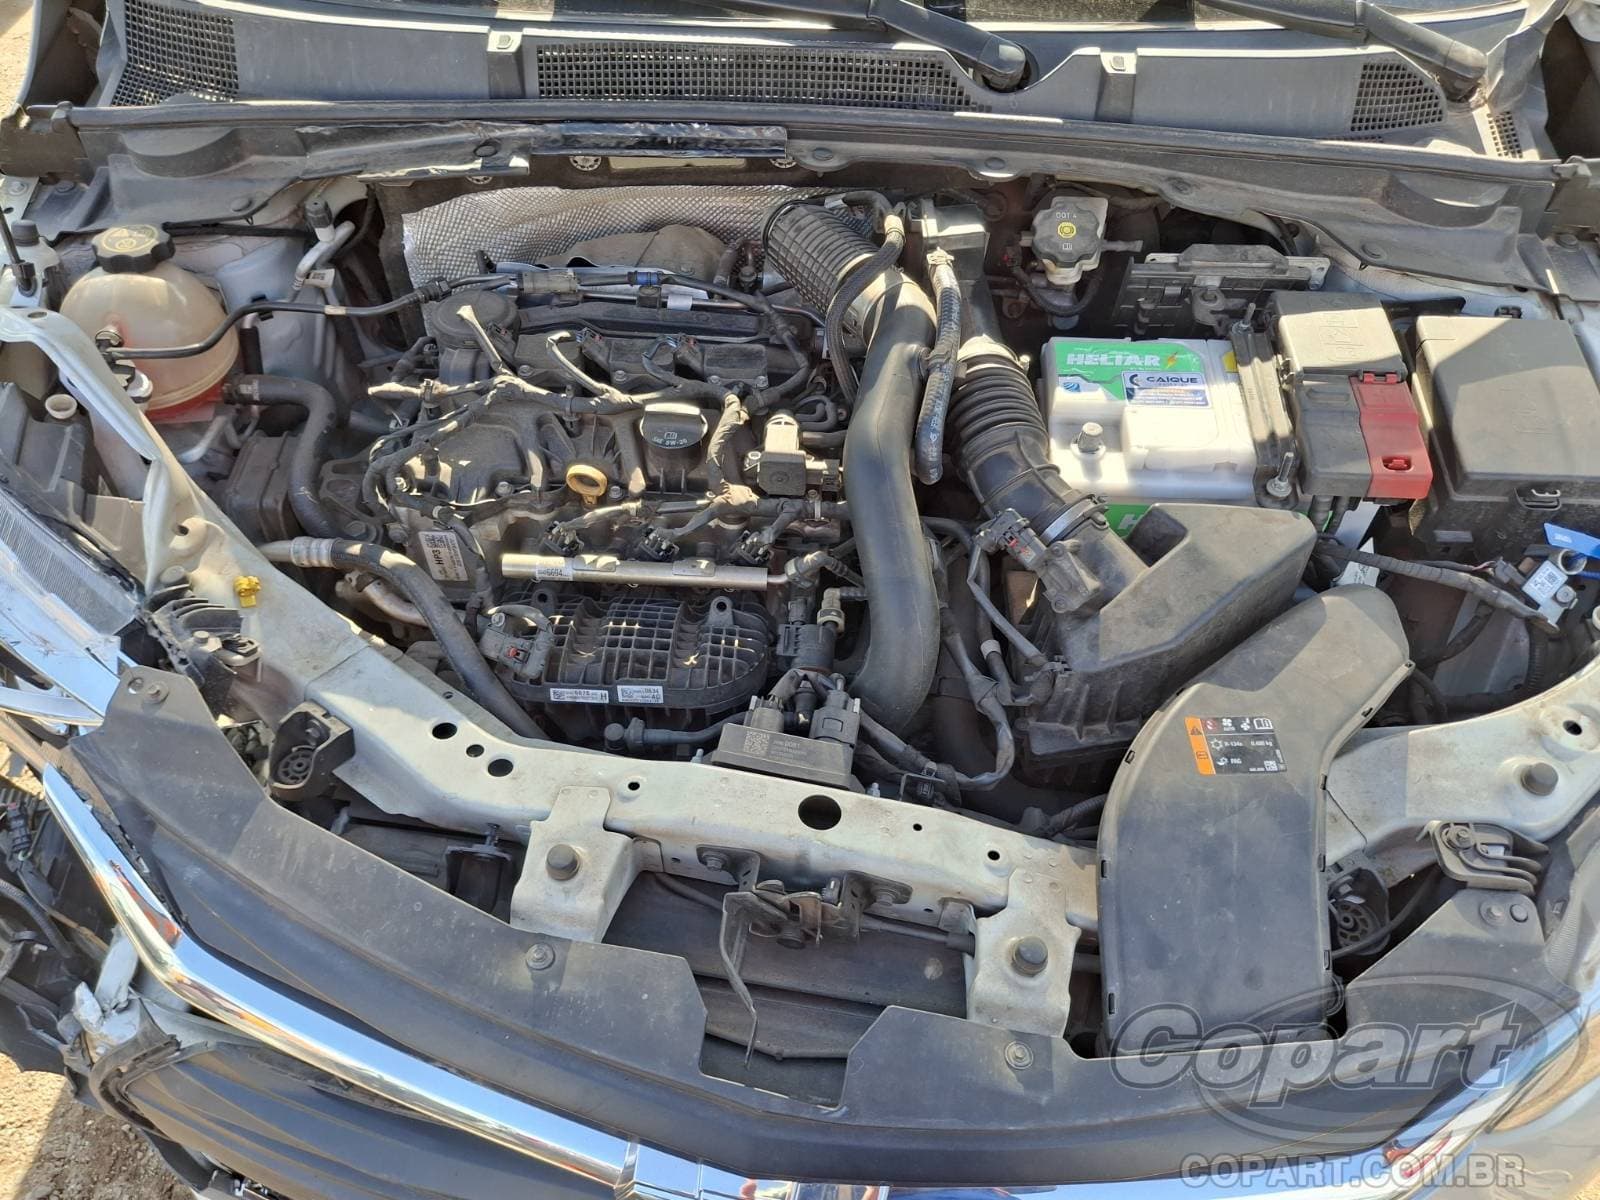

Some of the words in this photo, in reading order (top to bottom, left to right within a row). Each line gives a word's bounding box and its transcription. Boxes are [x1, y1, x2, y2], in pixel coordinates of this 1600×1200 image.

[1146, 375, 1199, 384] CAIQUE
[432, 549, 444, 565] HP3
[600, 692, 608, 701] H
